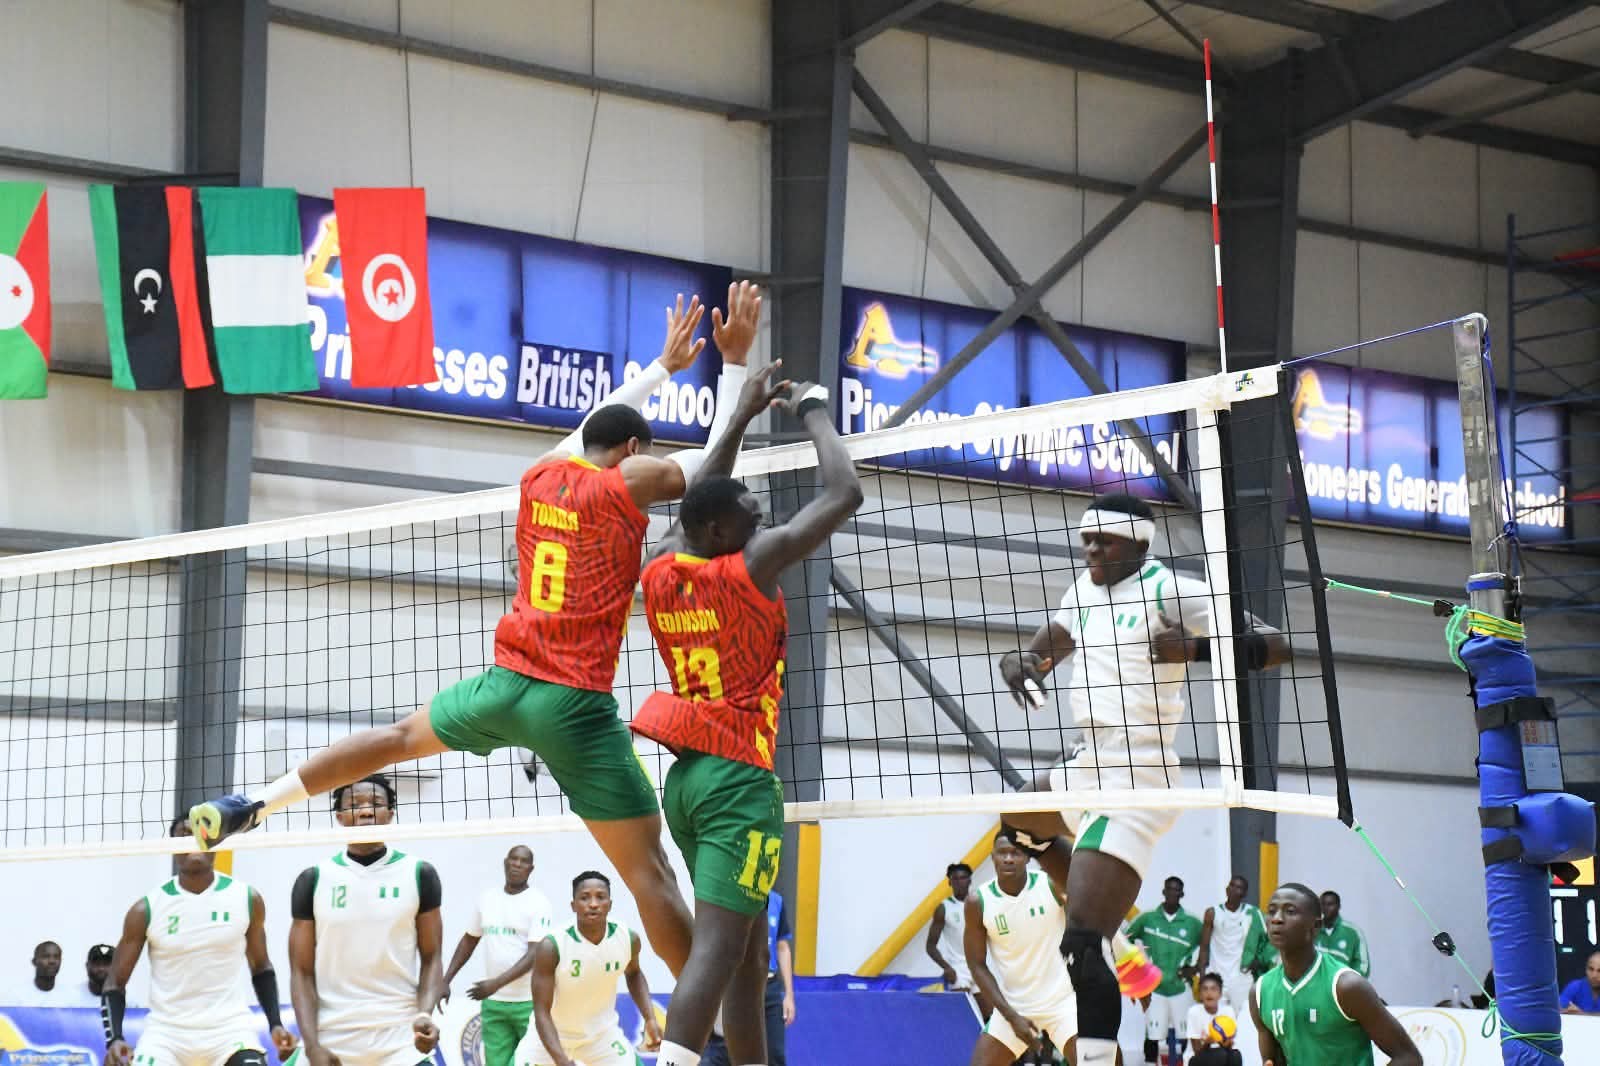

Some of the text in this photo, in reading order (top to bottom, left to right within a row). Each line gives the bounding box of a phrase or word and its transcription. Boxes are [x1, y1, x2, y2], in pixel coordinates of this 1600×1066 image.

[307, 304, 722, 428] Prisses British choo
[973, 402, 1083, 475] Oympic
[1287, 450, 1381, 505] oneers
[531, 541, 568, 614] 8
[671, 646, 724, 702] 13
[331, 885, 347, 909] 12
[167, 915, 180, 935] 2
[995, 914, 1009, 934] 10
[571, 959, 581, 977] 3
[611, 1040, 627, 1056] 3
